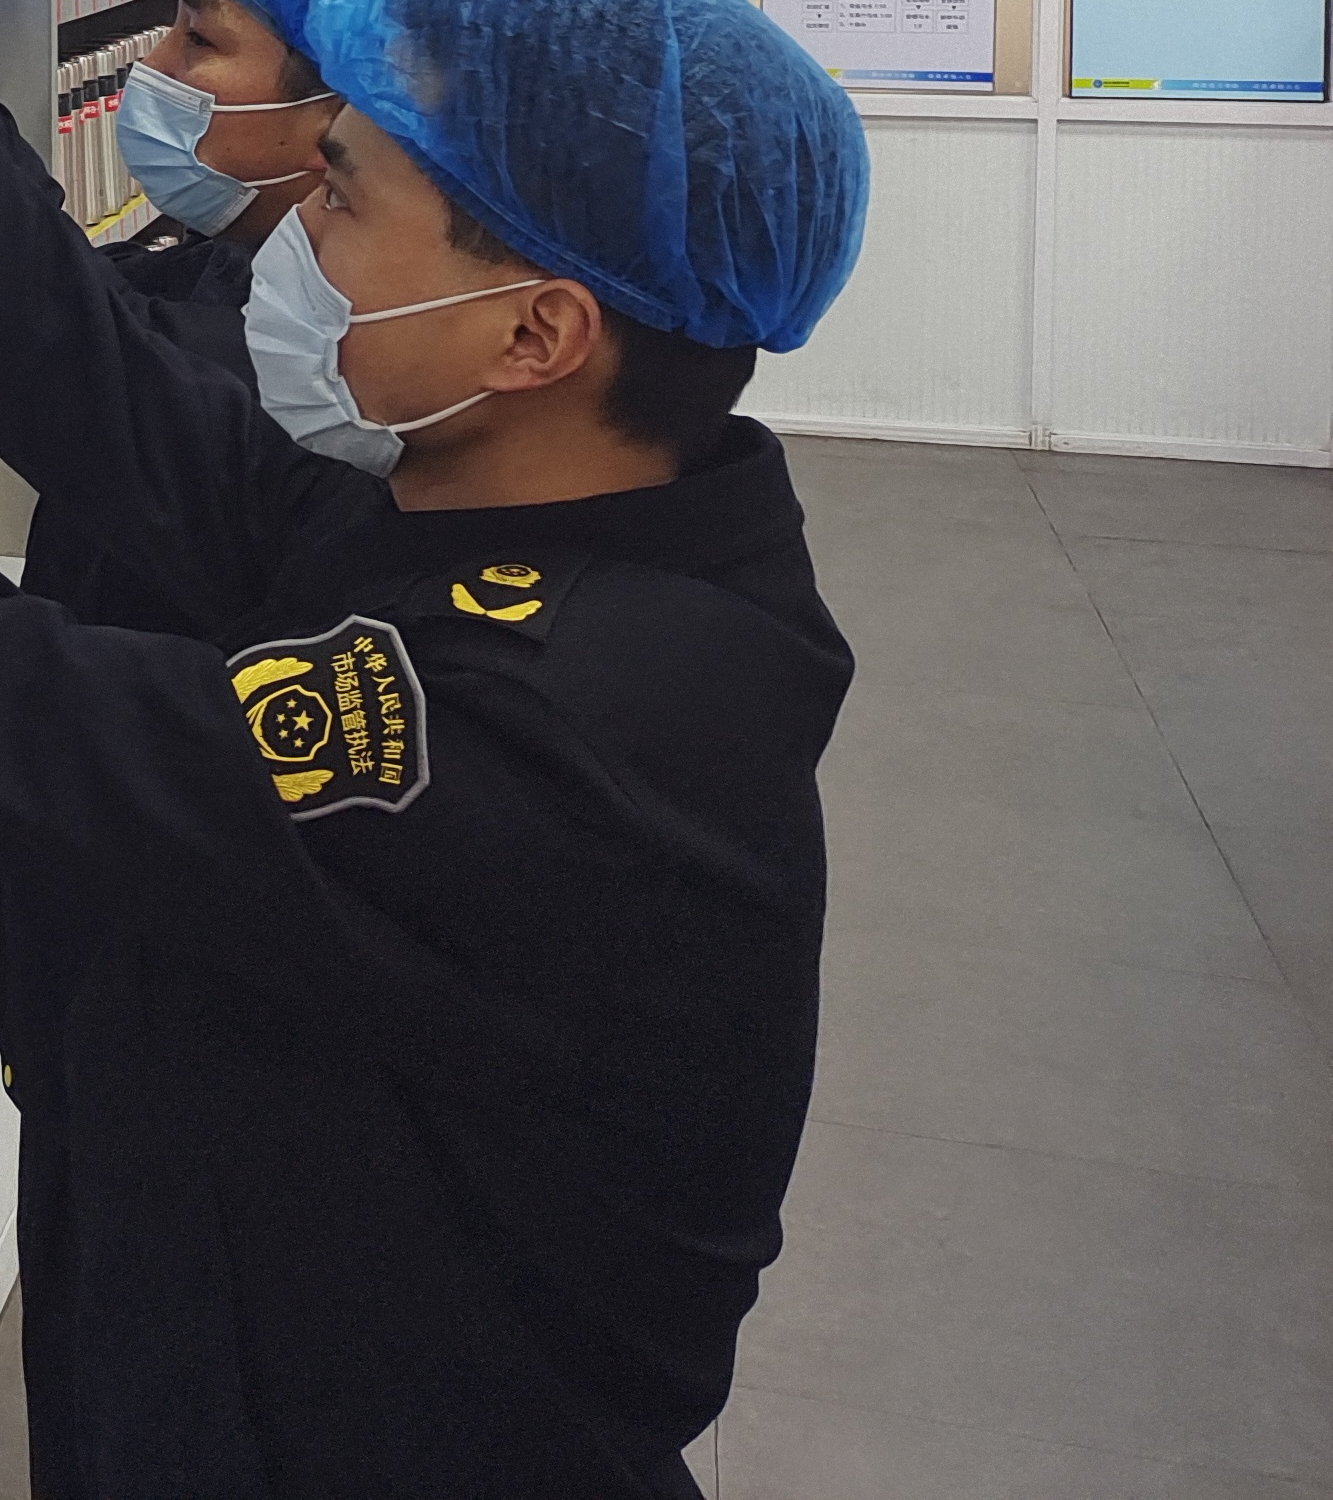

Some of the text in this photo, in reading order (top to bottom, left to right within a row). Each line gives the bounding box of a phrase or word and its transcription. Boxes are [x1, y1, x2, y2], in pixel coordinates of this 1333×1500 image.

[330, 651, 376, 776] 市场监管执法
[352, 636, 406, 786] 中华人民共和国
